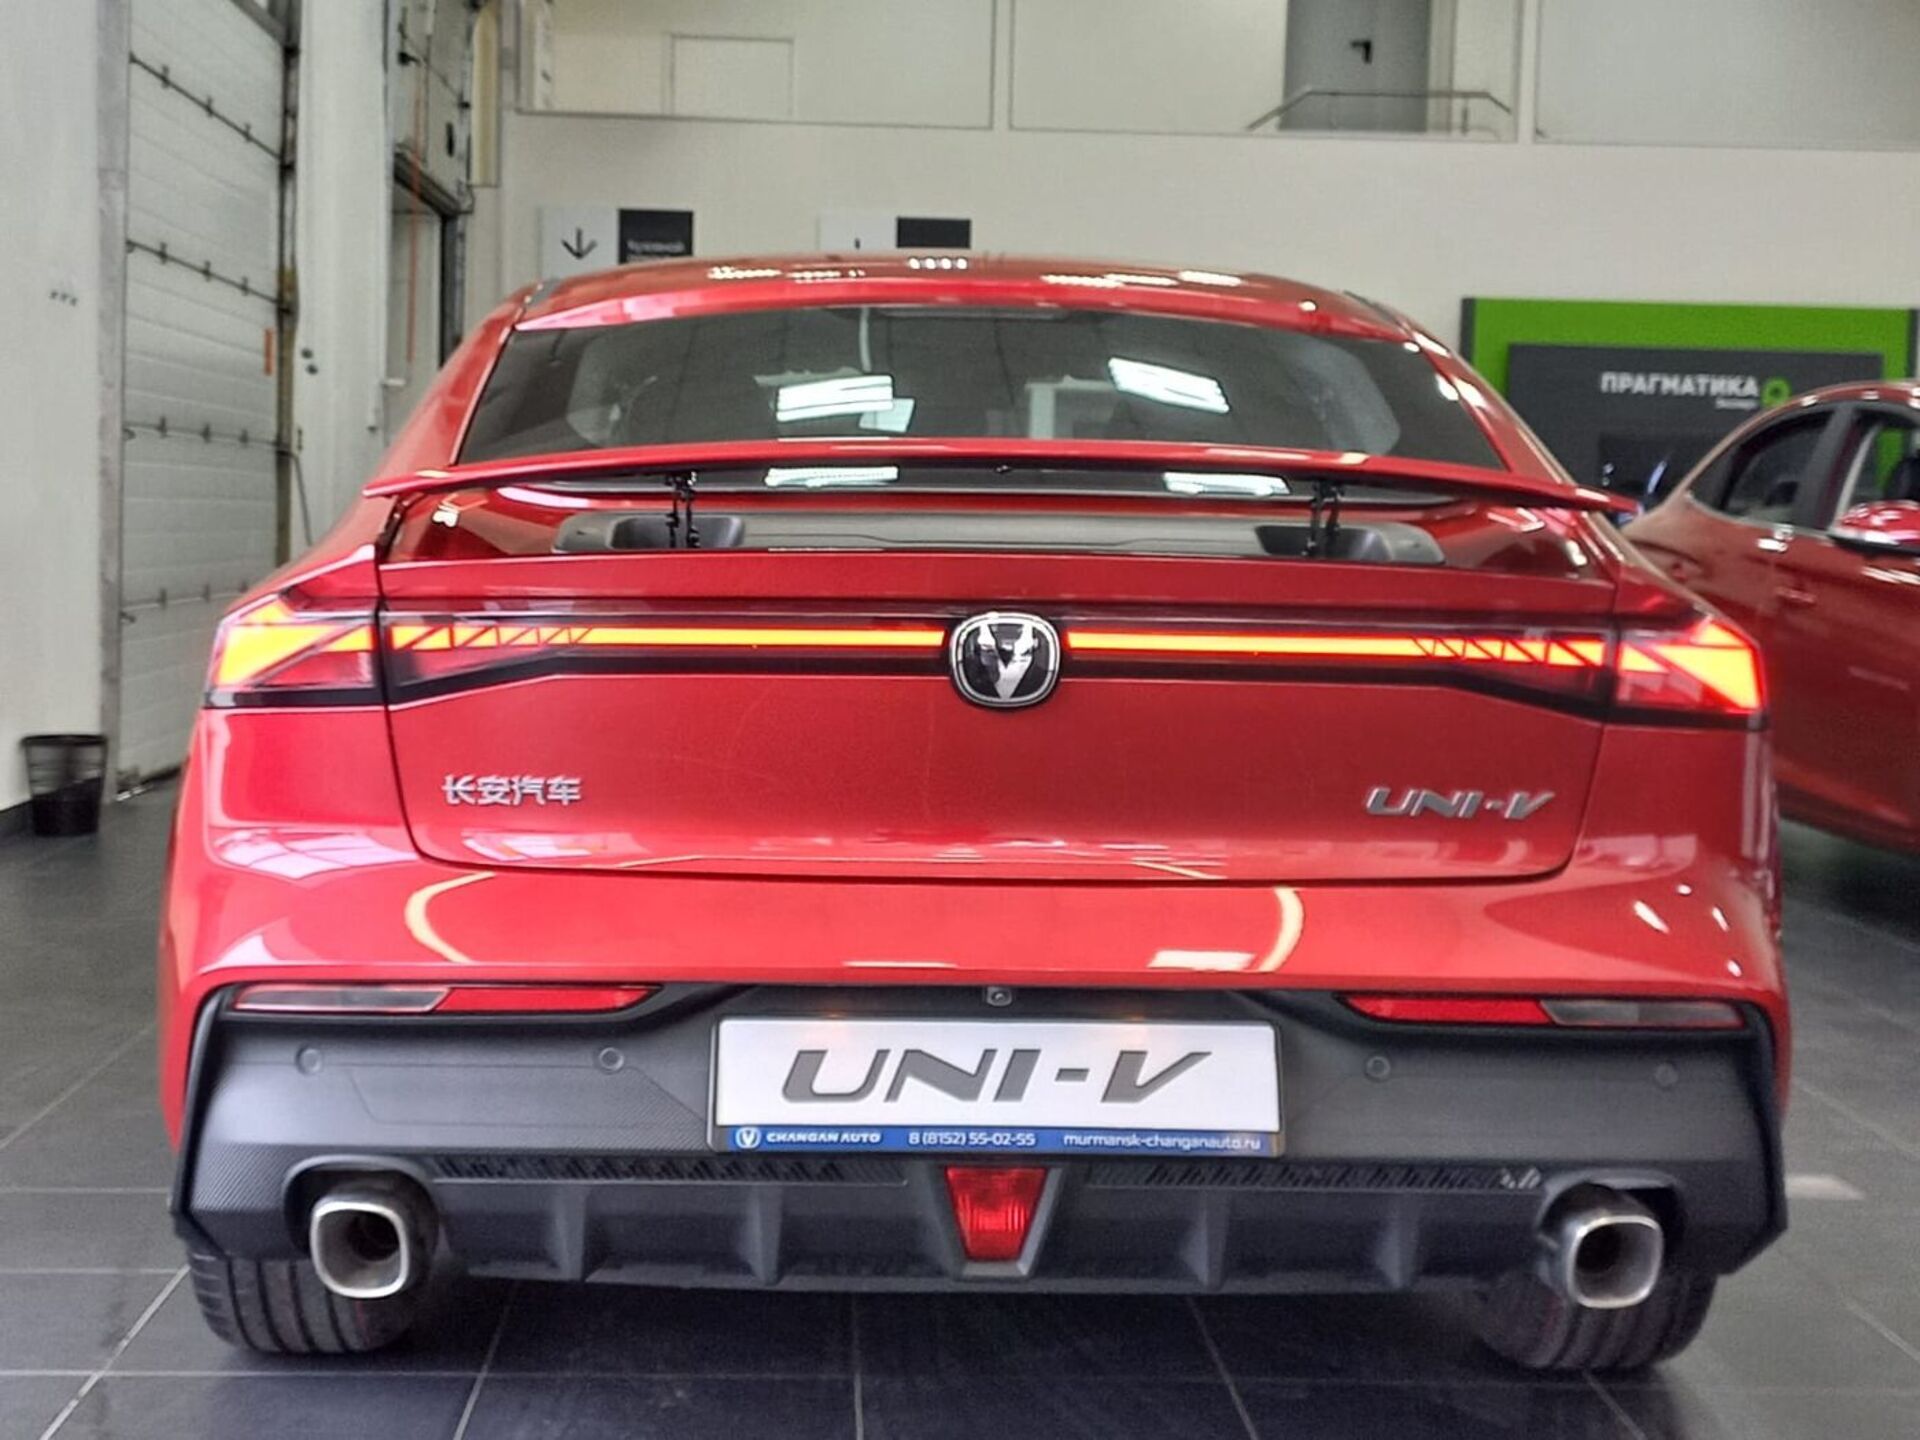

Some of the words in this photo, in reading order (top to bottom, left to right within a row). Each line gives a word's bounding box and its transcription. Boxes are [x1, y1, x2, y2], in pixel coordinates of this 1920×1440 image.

[1600, 371, 1759, 397] ПРАГМАТИКА
[441, 774, 582, 806] 长安汽车
[1366, 787, 1555, 820] UNI-V
[781, 1048, 1212, 1103] UNI-V
[766, 1132, 840, 1144] CHANGAN
[840, 1133, 882, 1144] AUTO
[908, 1132, 919, 1146] 8
[922, 1131, 966, 1147] (8152)
[968, 1132, 1036, 1147] 55-02-55
[1063, 1133, 1261, 1151] murmansk-changanauto.ru
